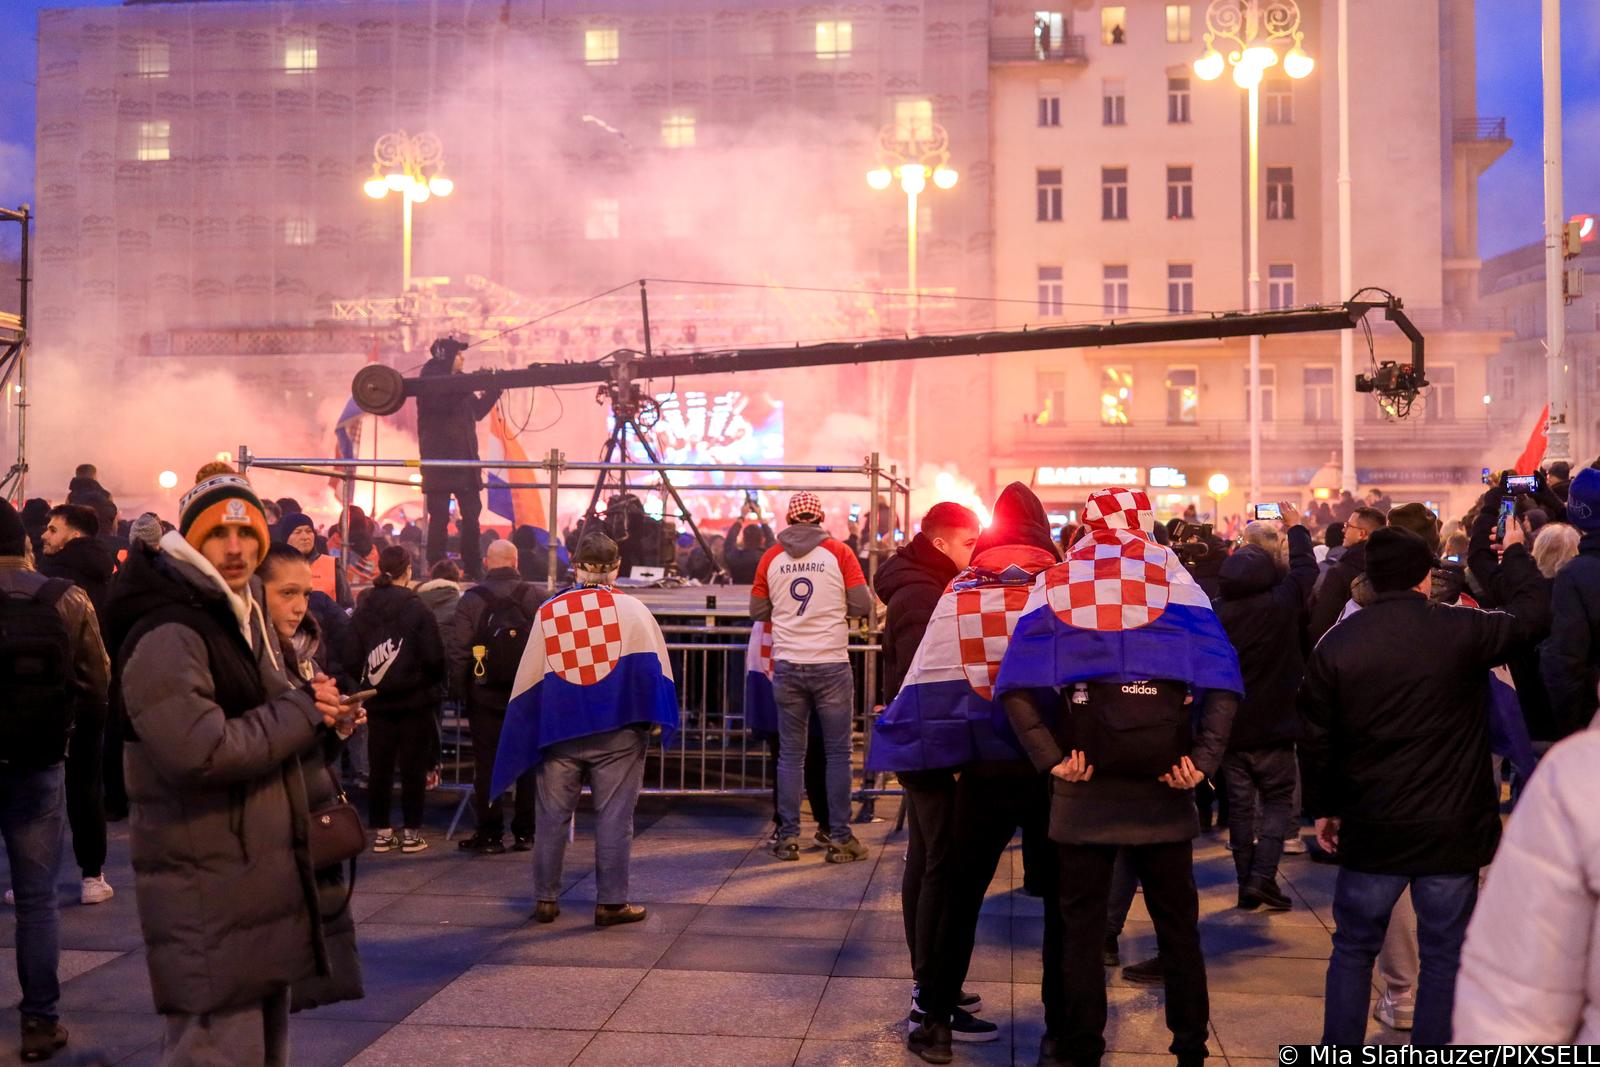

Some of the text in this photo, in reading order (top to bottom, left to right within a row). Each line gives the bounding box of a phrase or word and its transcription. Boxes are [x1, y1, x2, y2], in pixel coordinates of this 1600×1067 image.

[780, 561, 825, 574] KRAMARIĆ
[790, 577, 813, 616] 9
[1121, 685, 1158, 695] adidas
